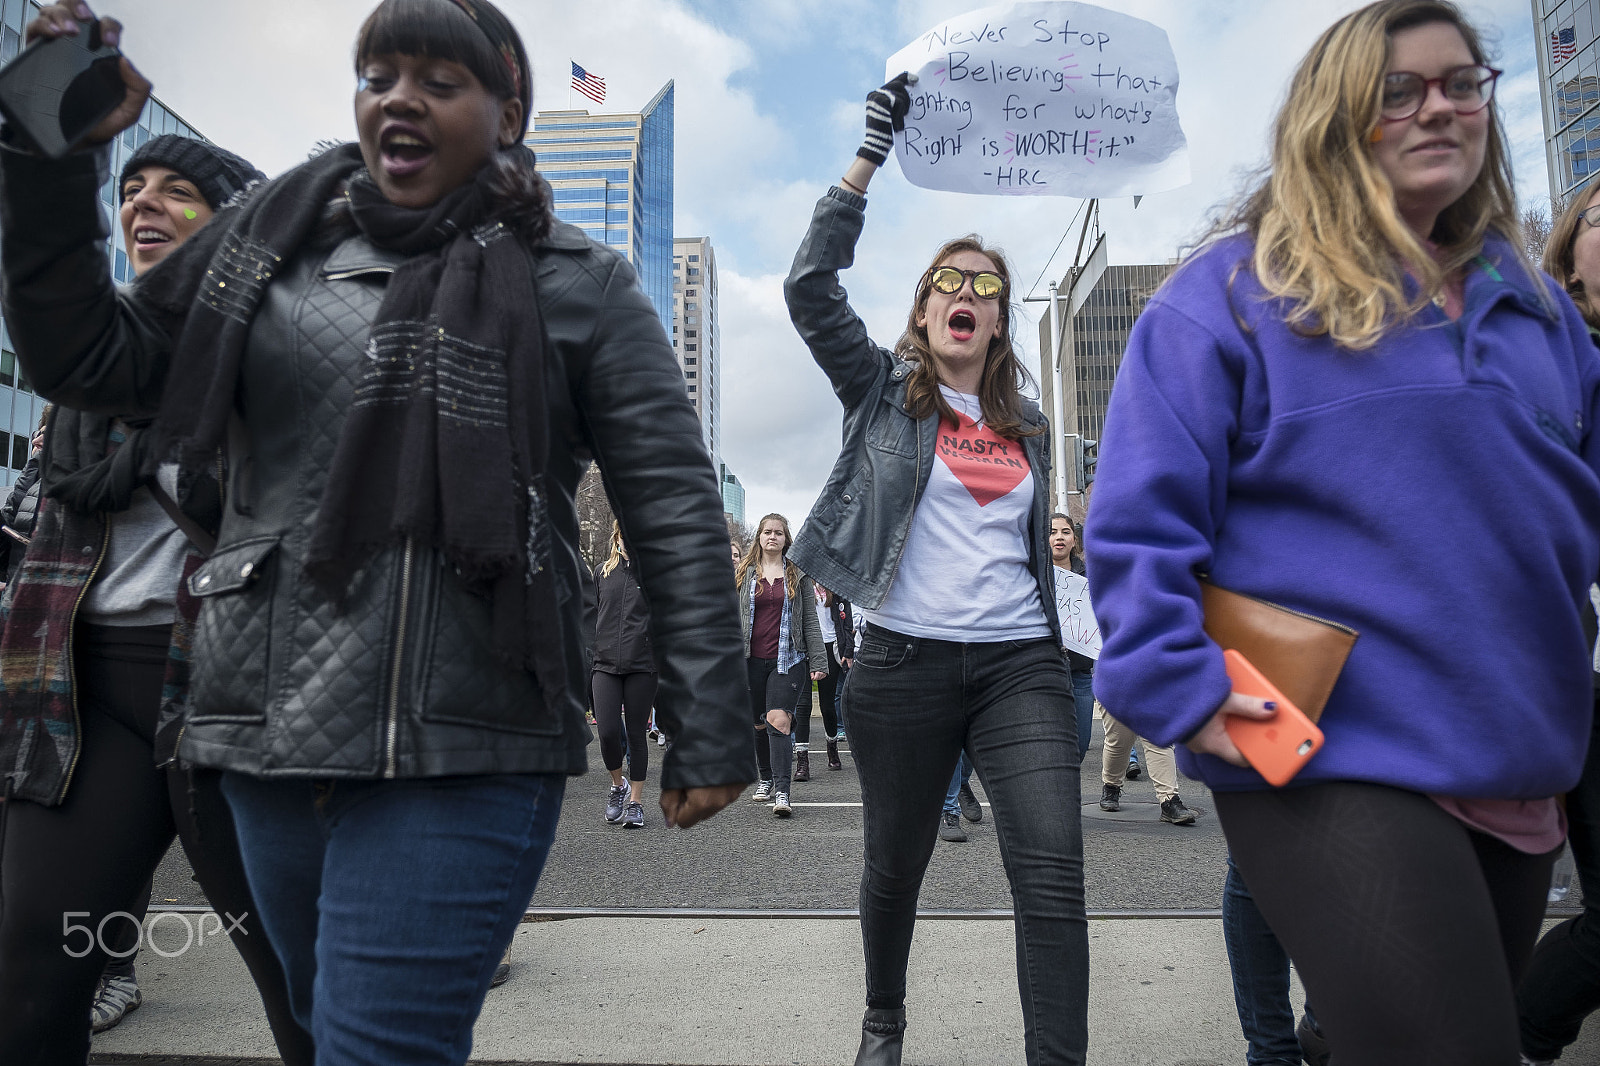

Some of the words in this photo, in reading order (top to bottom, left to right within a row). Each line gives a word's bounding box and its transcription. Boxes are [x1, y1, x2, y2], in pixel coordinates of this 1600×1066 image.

[1033, 19, 1110, 52] Stop
[948, 51, 1064, 92] Believing
[1090, 63, 1162, 93] that
[909, 91, 973, 131] ighting
[1002, 94, 1046, 121] for
[1075, 98, 1152, 124] what's
[904, 126, 963, 164] Right
[982, 137, 999, 157] is
[1015, 130, 1088, 157] WORTH
[943, 435, 1008, 456] NASTY
